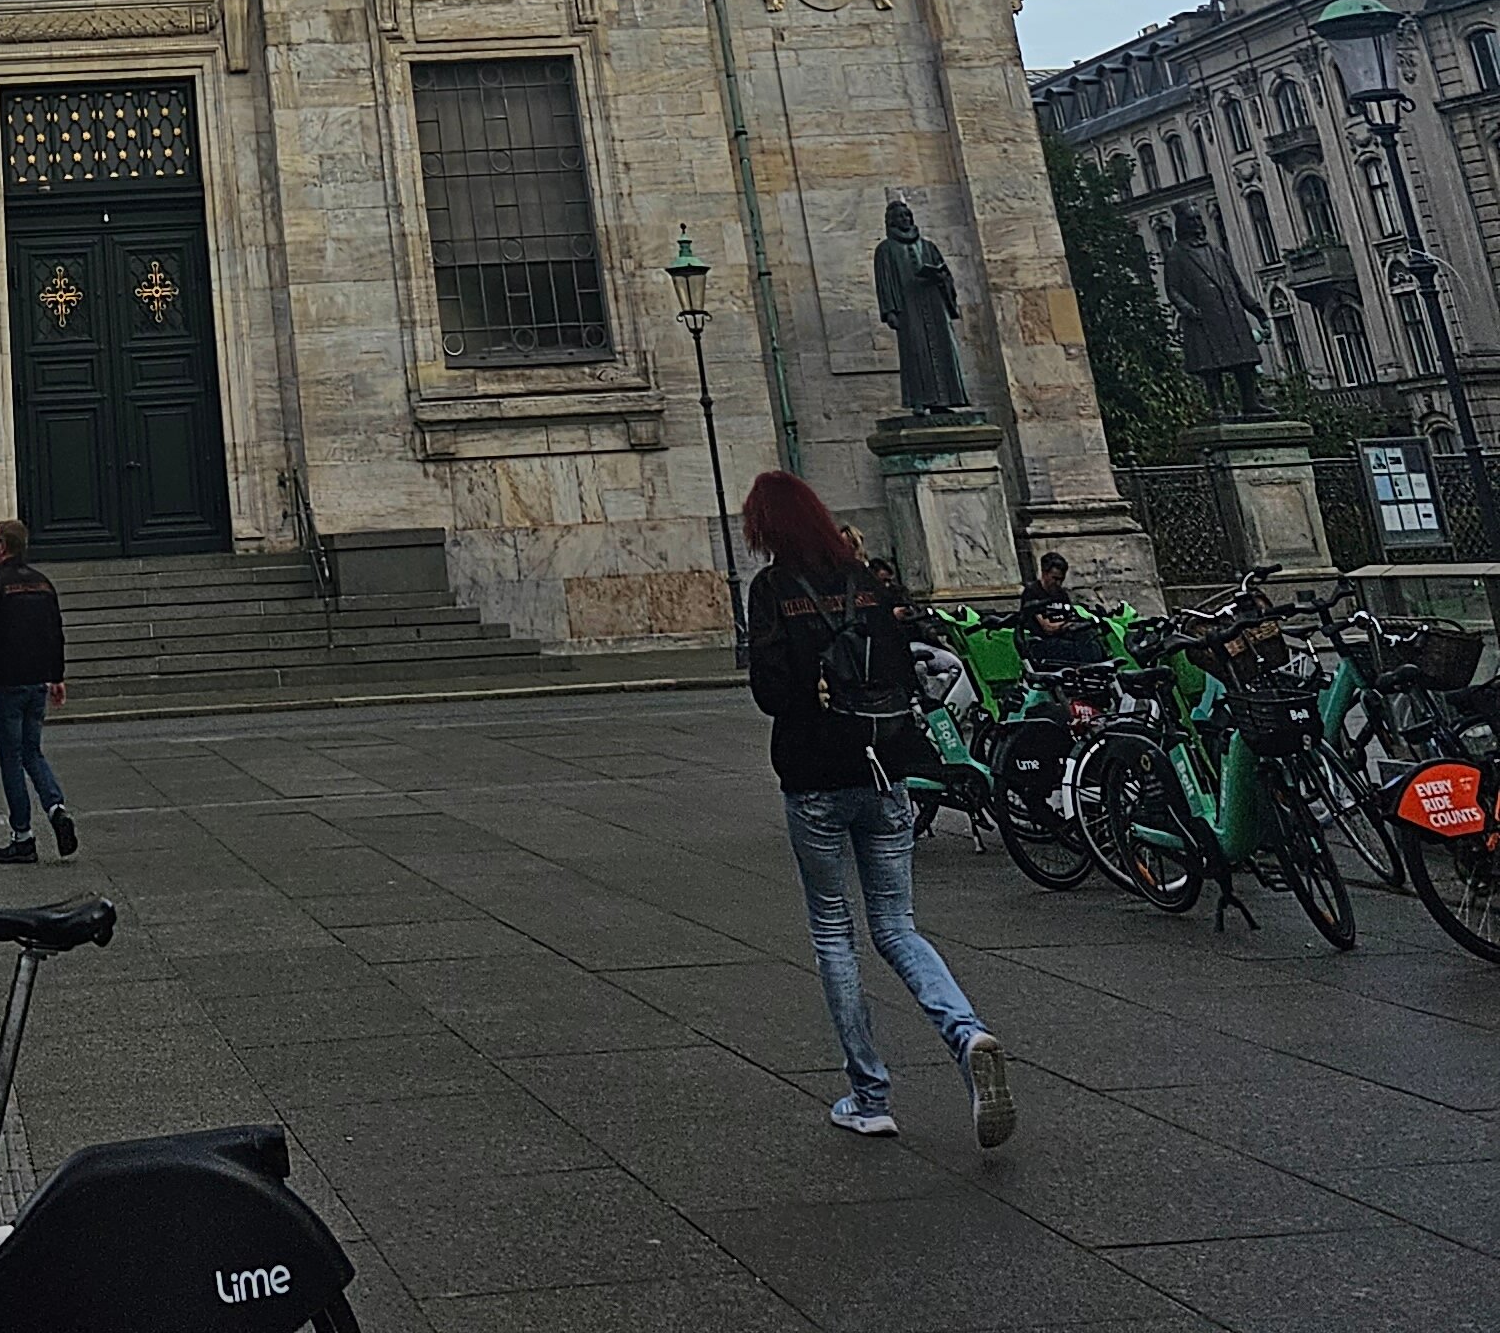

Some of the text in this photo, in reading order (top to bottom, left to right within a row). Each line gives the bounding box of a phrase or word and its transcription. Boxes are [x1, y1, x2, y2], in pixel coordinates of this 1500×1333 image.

[936, 720, 958, 750] Bolt
[1414, 779, 1453, 798] EVERY
[1421, 795, 1454, 813] RIDE
[1429, 807, 1482, 827] COUNTS
[215, 1264, 291, 1304] Lime
